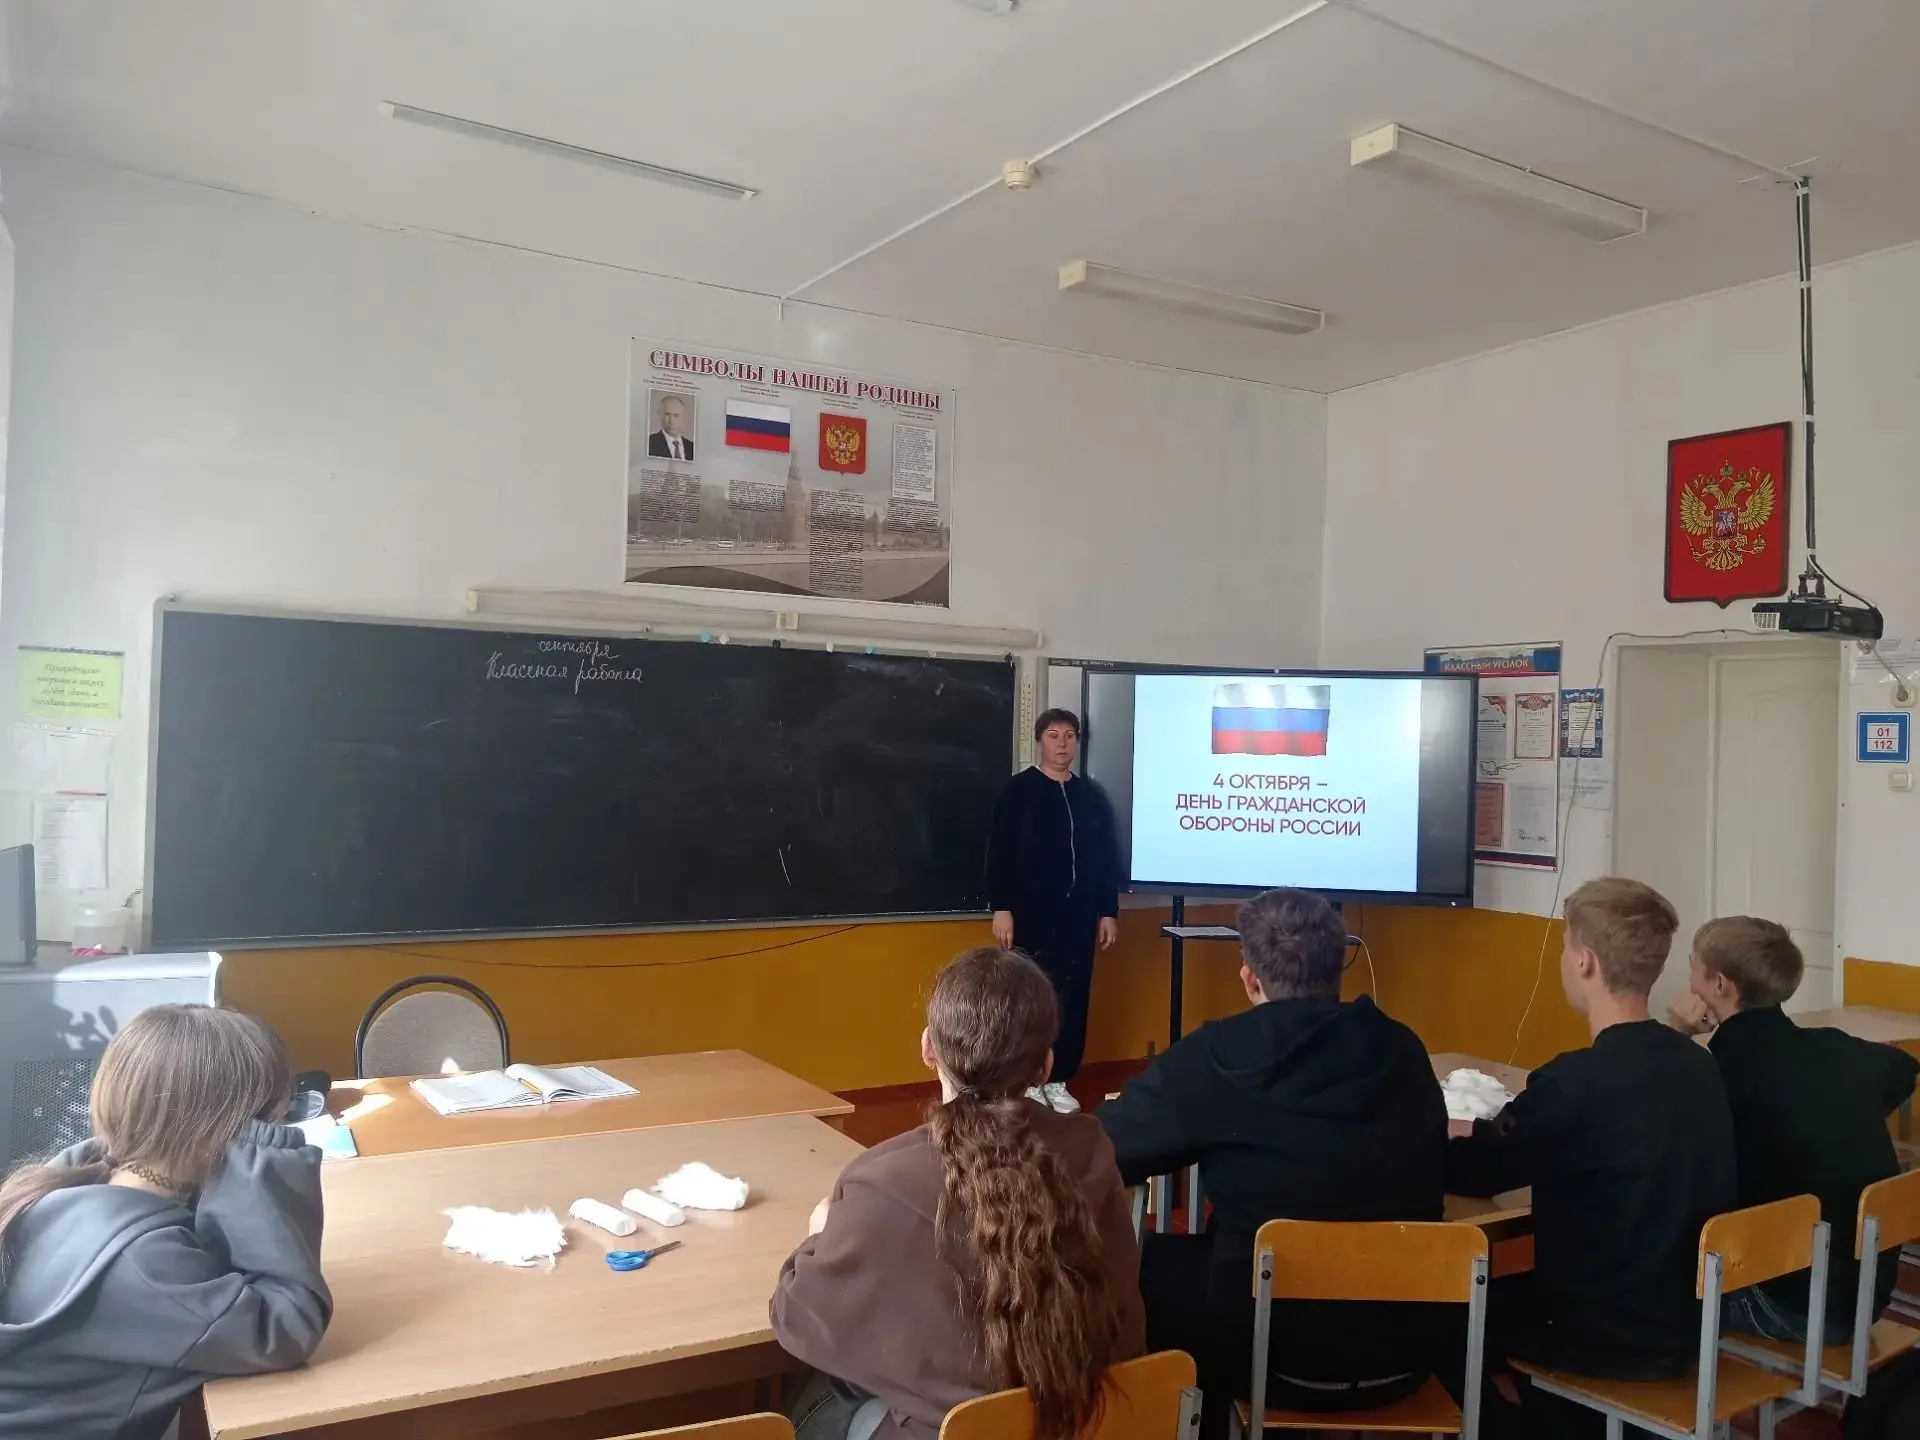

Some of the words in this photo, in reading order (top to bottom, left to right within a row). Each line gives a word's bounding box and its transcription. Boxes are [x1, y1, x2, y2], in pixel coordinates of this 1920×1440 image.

[649, 349, 765, 382] СИМВОЛЫ
[772, 367, 850, 396] НАШЕЙ
[857, 382, 942, 411] РОДИНЫ
[539, 640, 620, 665] сентября
[486, 651, 568, 680] Классная
[574, 659, 643, 694] работа
[1444, 661, 1491, 673] КЛАССНЫЙ
[1493, 659, 1529, 669] УГОЛОК
[1877, 727, 1890, 737] 01
[1873, 740, 1893, 750] 112
[1213, 773, 1225, 788] 4
[1229, 774, 1310, 791] ОКТЯБРЯ
[1176, 793, 1222, 811] ДЕНЬ
[1227, 796, 1366, 815] ГРАЖДАНСКОЙ
[1179, 815, 1275, 833] ОБОРОНЫ
[1280, 818, 1361, 836] РОССИИ
